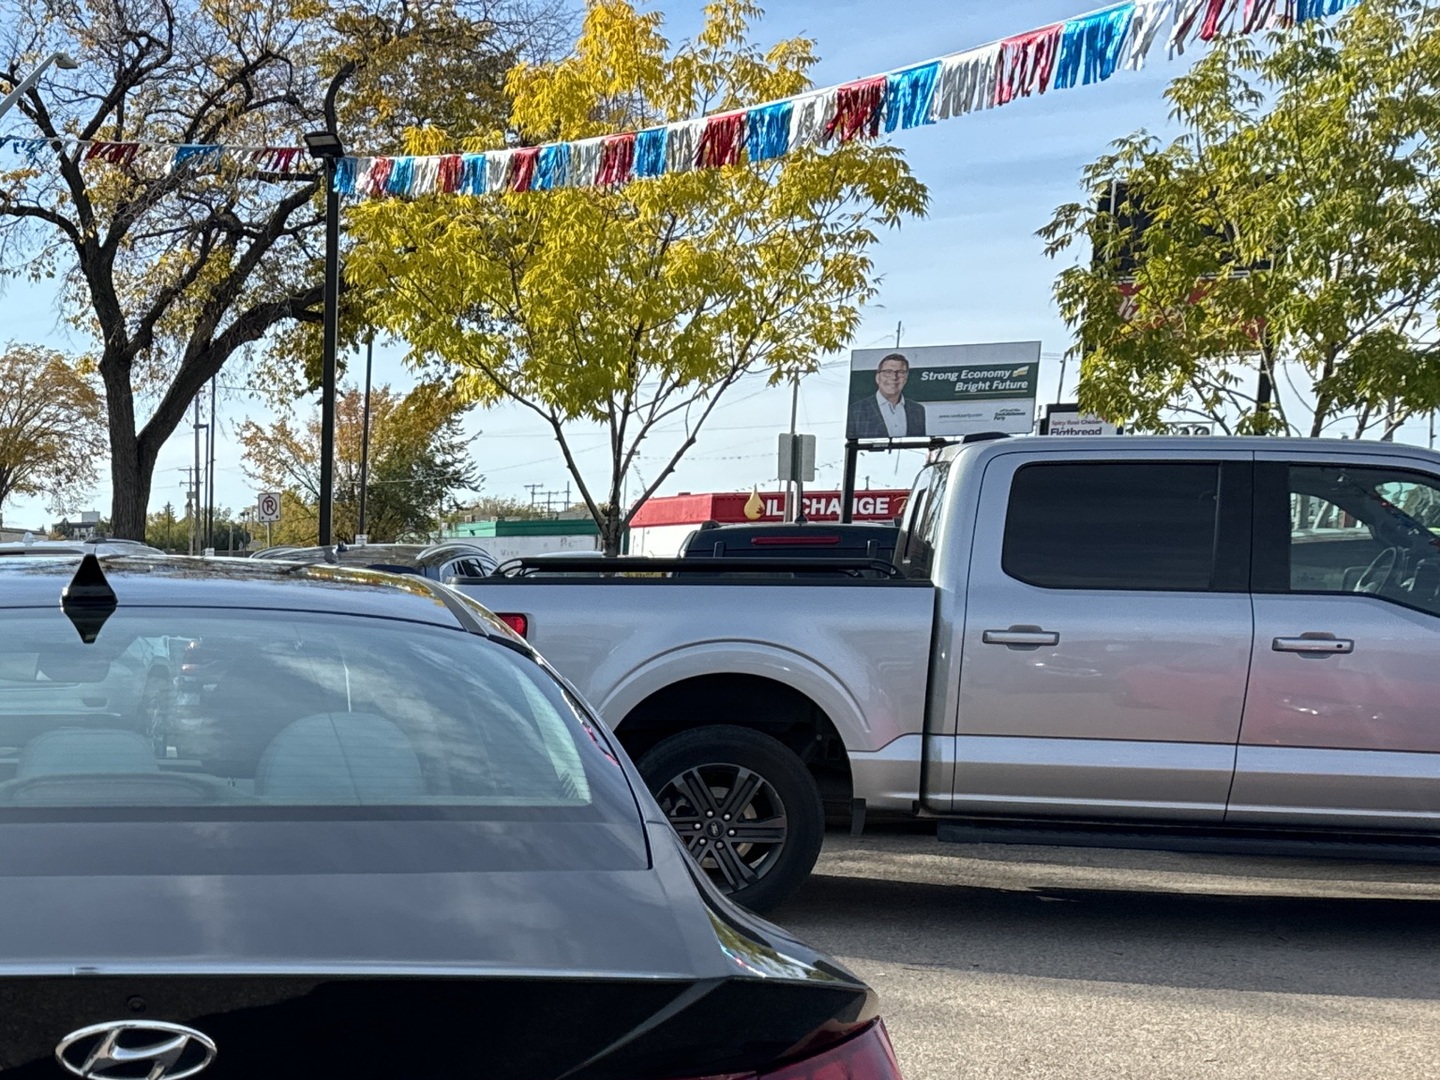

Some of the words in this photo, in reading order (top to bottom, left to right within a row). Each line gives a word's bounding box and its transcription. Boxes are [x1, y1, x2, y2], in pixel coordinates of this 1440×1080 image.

[920, 371, 959, 381] Strong
[960, 369, 1012, 379] Economy
[954, 382, 990, 392] Bright
[992, 381, 1029, 390] Future
[1050, 427, 1102, 435] Flatbread
[801, 497, 890, 515] CHAGE
